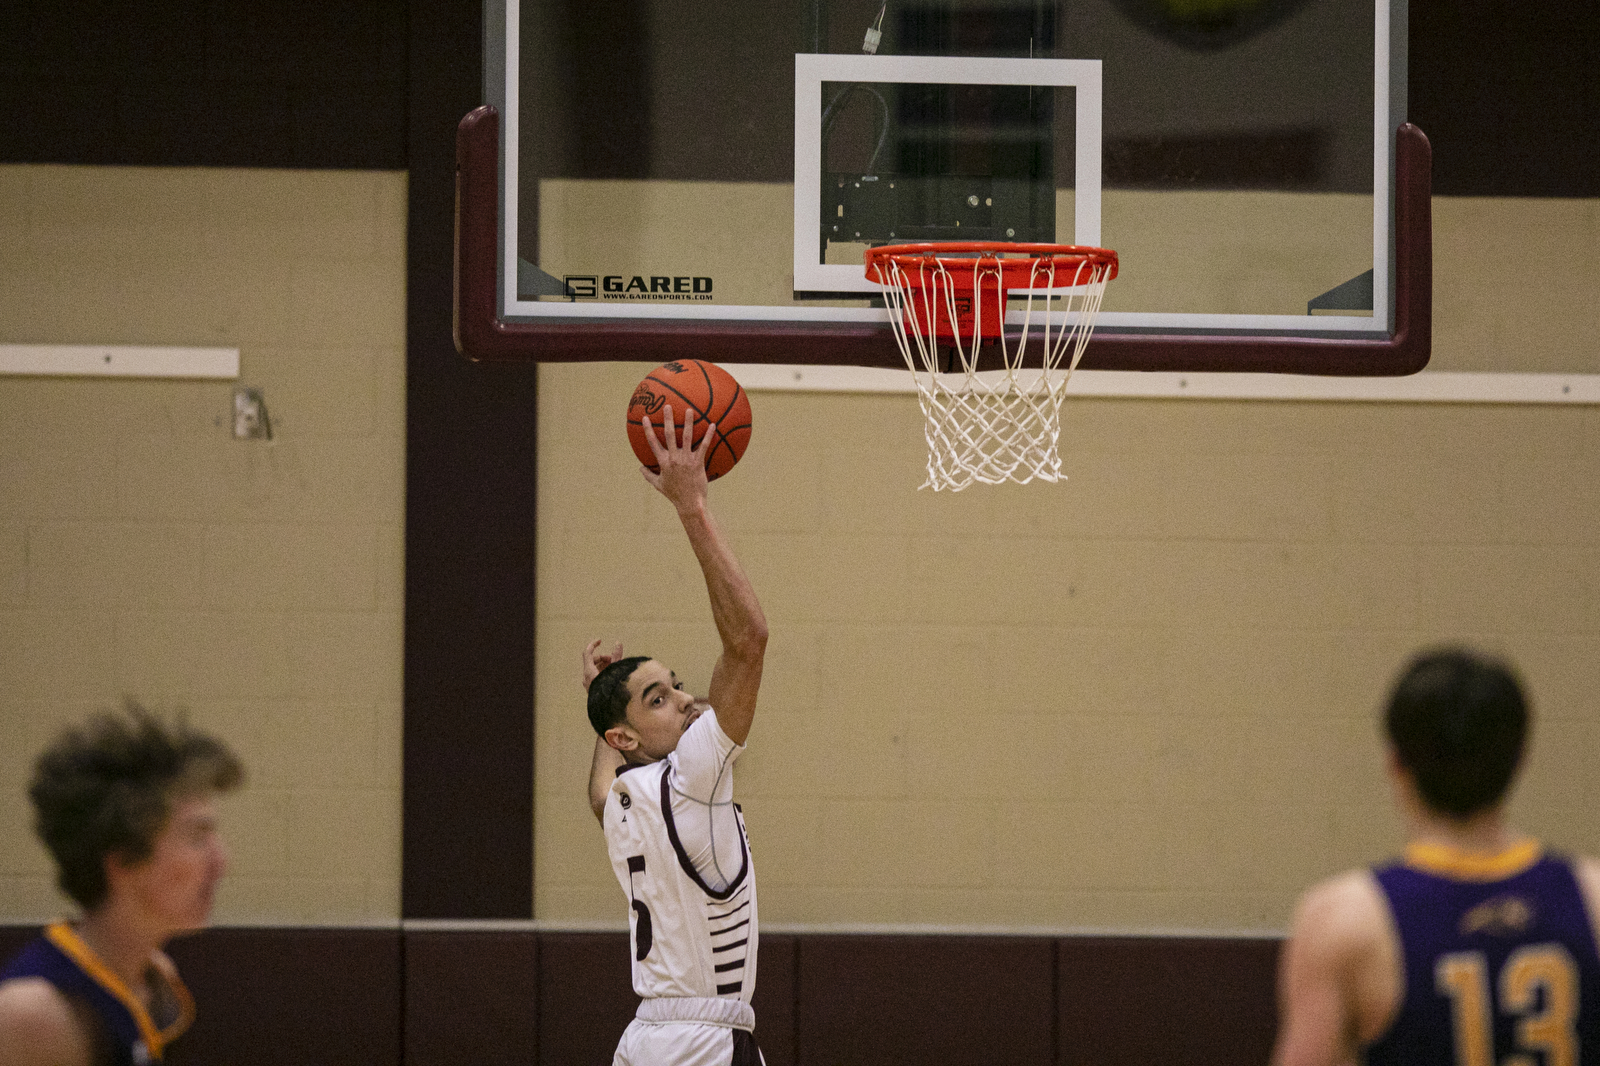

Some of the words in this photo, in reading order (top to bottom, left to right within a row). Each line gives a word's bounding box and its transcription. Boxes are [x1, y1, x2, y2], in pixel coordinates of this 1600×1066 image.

[603, 276, 713, 293] GARED
[603, 293, 713, 301] WWW.GAREDSPORTS.COM
[1434, 944, 1580, 1066] 13
